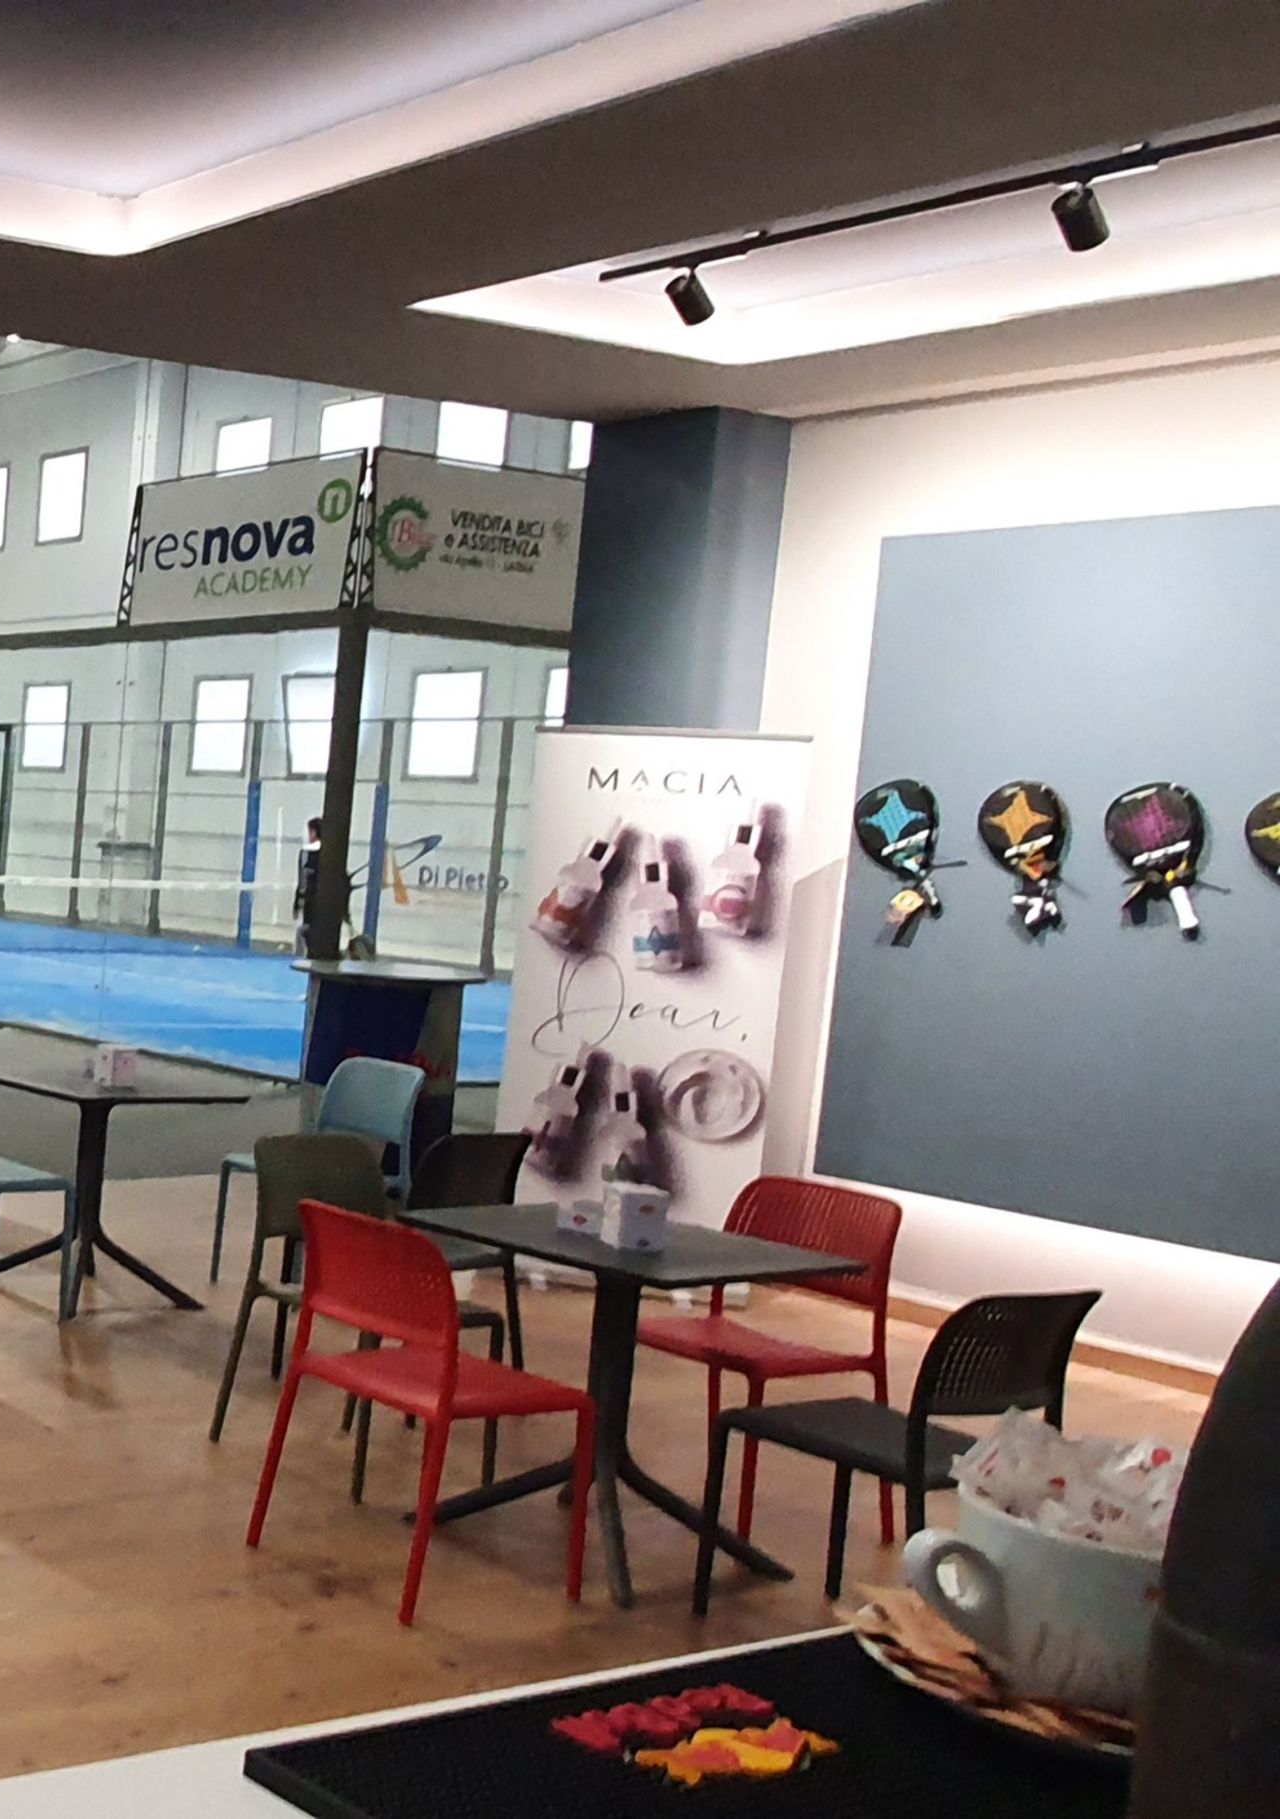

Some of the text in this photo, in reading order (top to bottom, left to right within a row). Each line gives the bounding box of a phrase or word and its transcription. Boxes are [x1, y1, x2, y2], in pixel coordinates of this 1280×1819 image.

[450, 508, 513, 534] VENDITA
[139, 515, 315, 573] resnova
[458, 532, 540, 558] ASSISTENZA
[194, 563, 313, 599] ACADEMY
[587, 765, 743, 797] MACIA
[418, 865, 509, 893] Di Pieto
